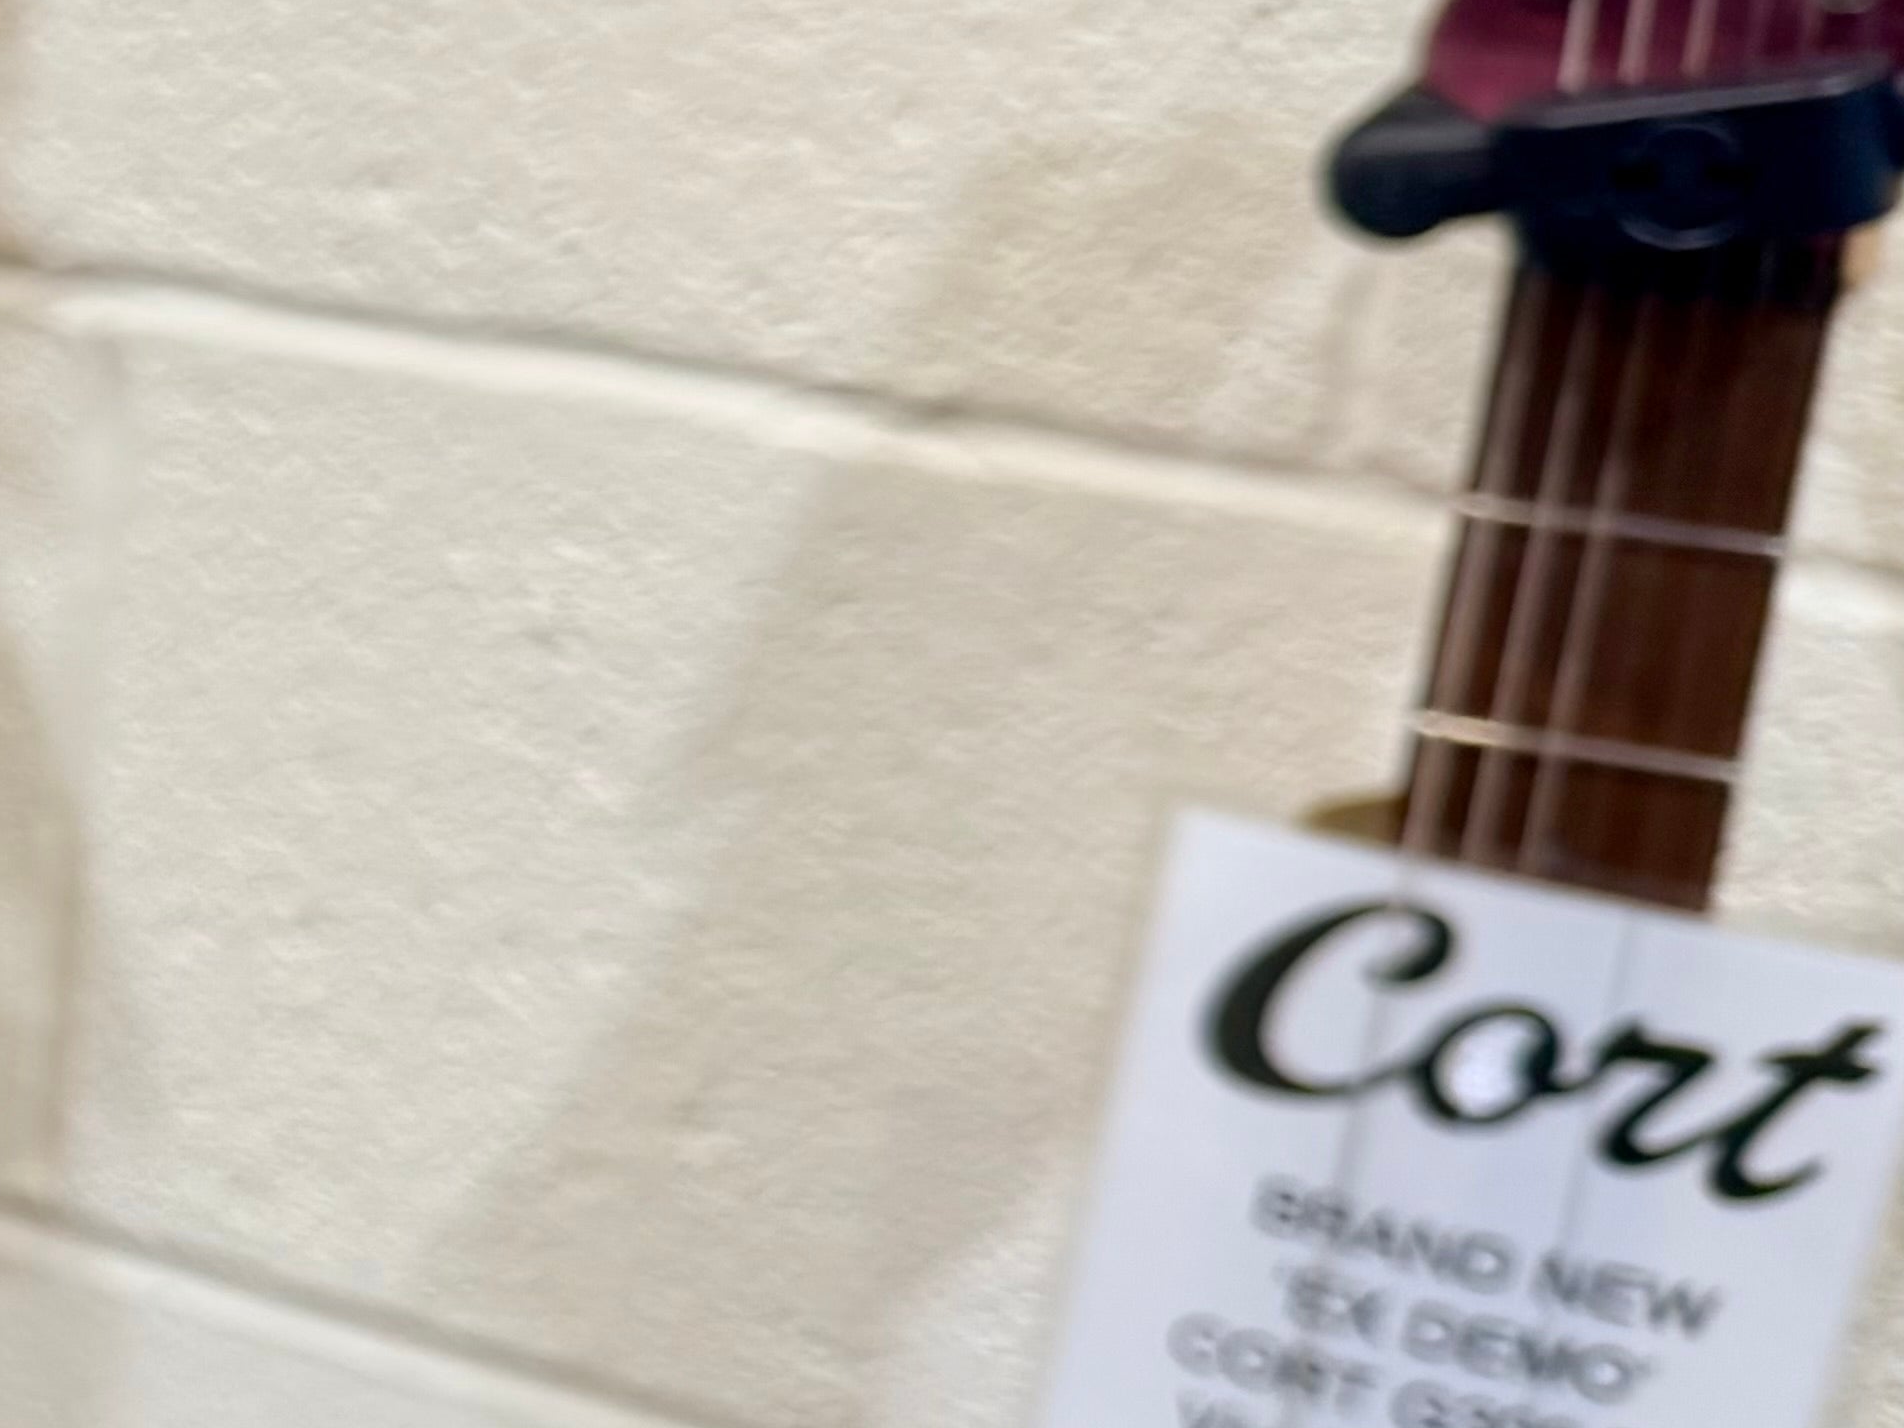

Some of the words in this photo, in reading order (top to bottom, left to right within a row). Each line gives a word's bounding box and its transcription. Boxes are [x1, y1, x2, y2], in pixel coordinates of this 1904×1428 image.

[1202, 898, 1884, 1202] Cort
[1250, 1175, 1518, 1294] BRAND
[1534, 1250, 1722, 1338] NEW
[1168, 1313, 1382, 1414] CORT
